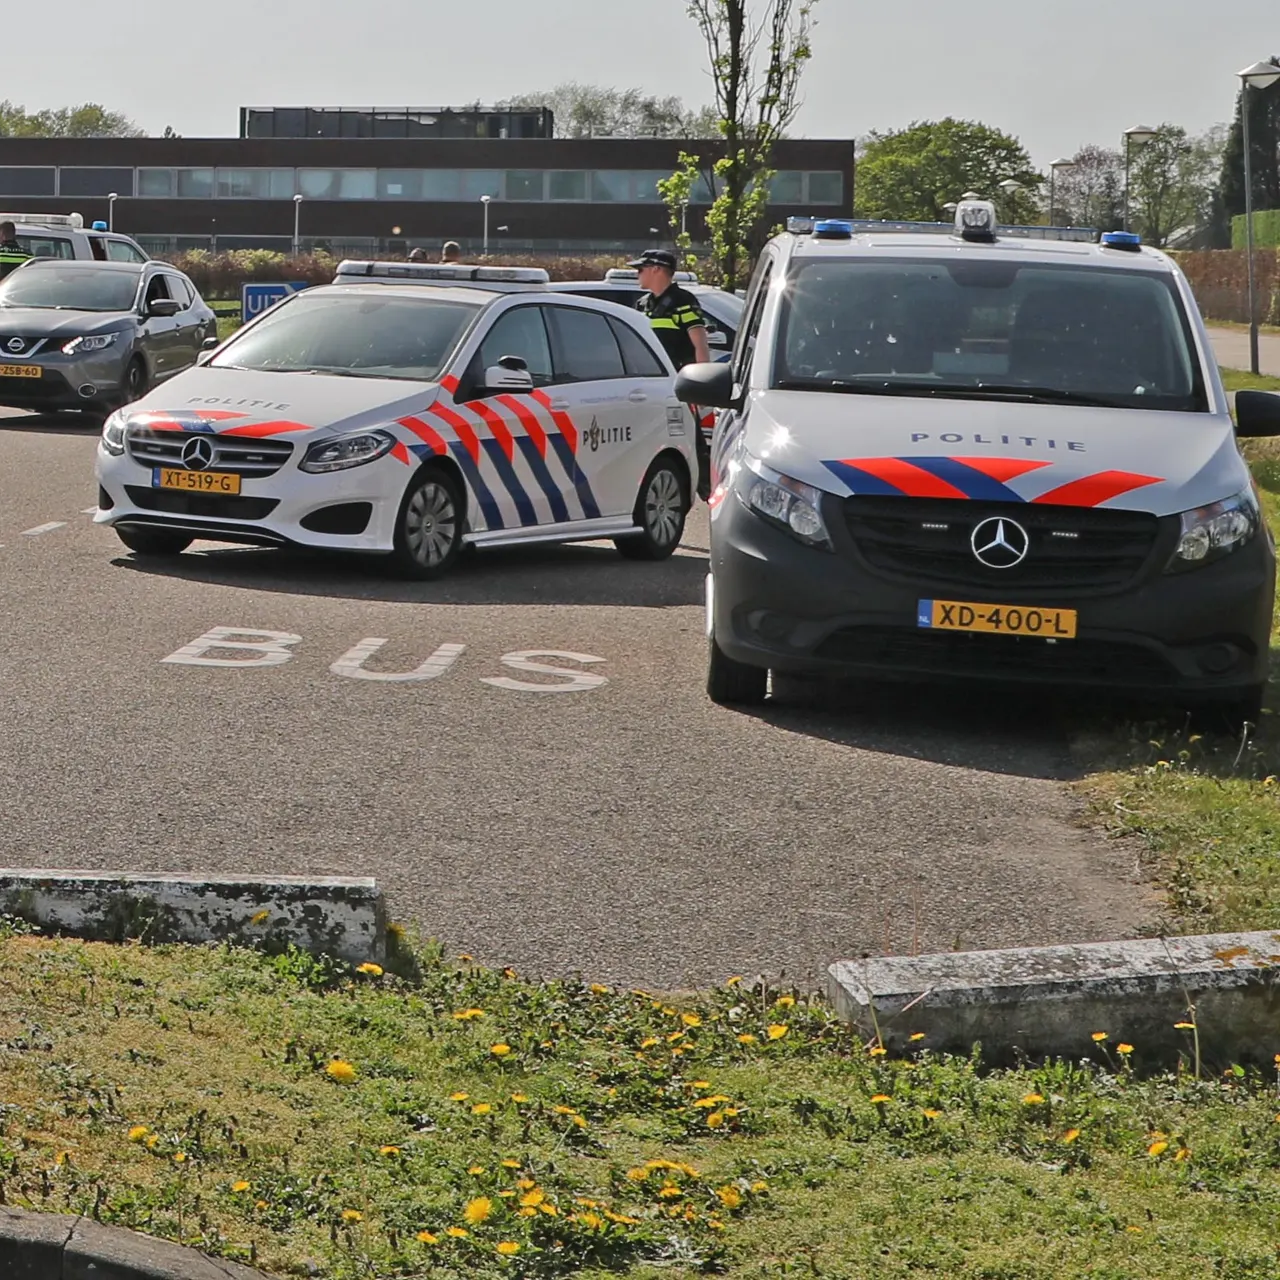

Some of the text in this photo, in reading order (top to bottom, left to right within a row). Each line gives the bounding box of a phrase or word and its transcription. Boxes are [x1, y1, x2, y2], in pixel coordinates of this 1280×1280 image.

[187, 396, 291, 412] POLITIE
[582, 417, 632, 452] POLITIE
[910, 433, 1087, 453] POLITIE
[165, 471, 231, 491] XT-519-G
[939, 604, 1069, 634] XD-400-L
[159, 626, 609, 692] BUS
